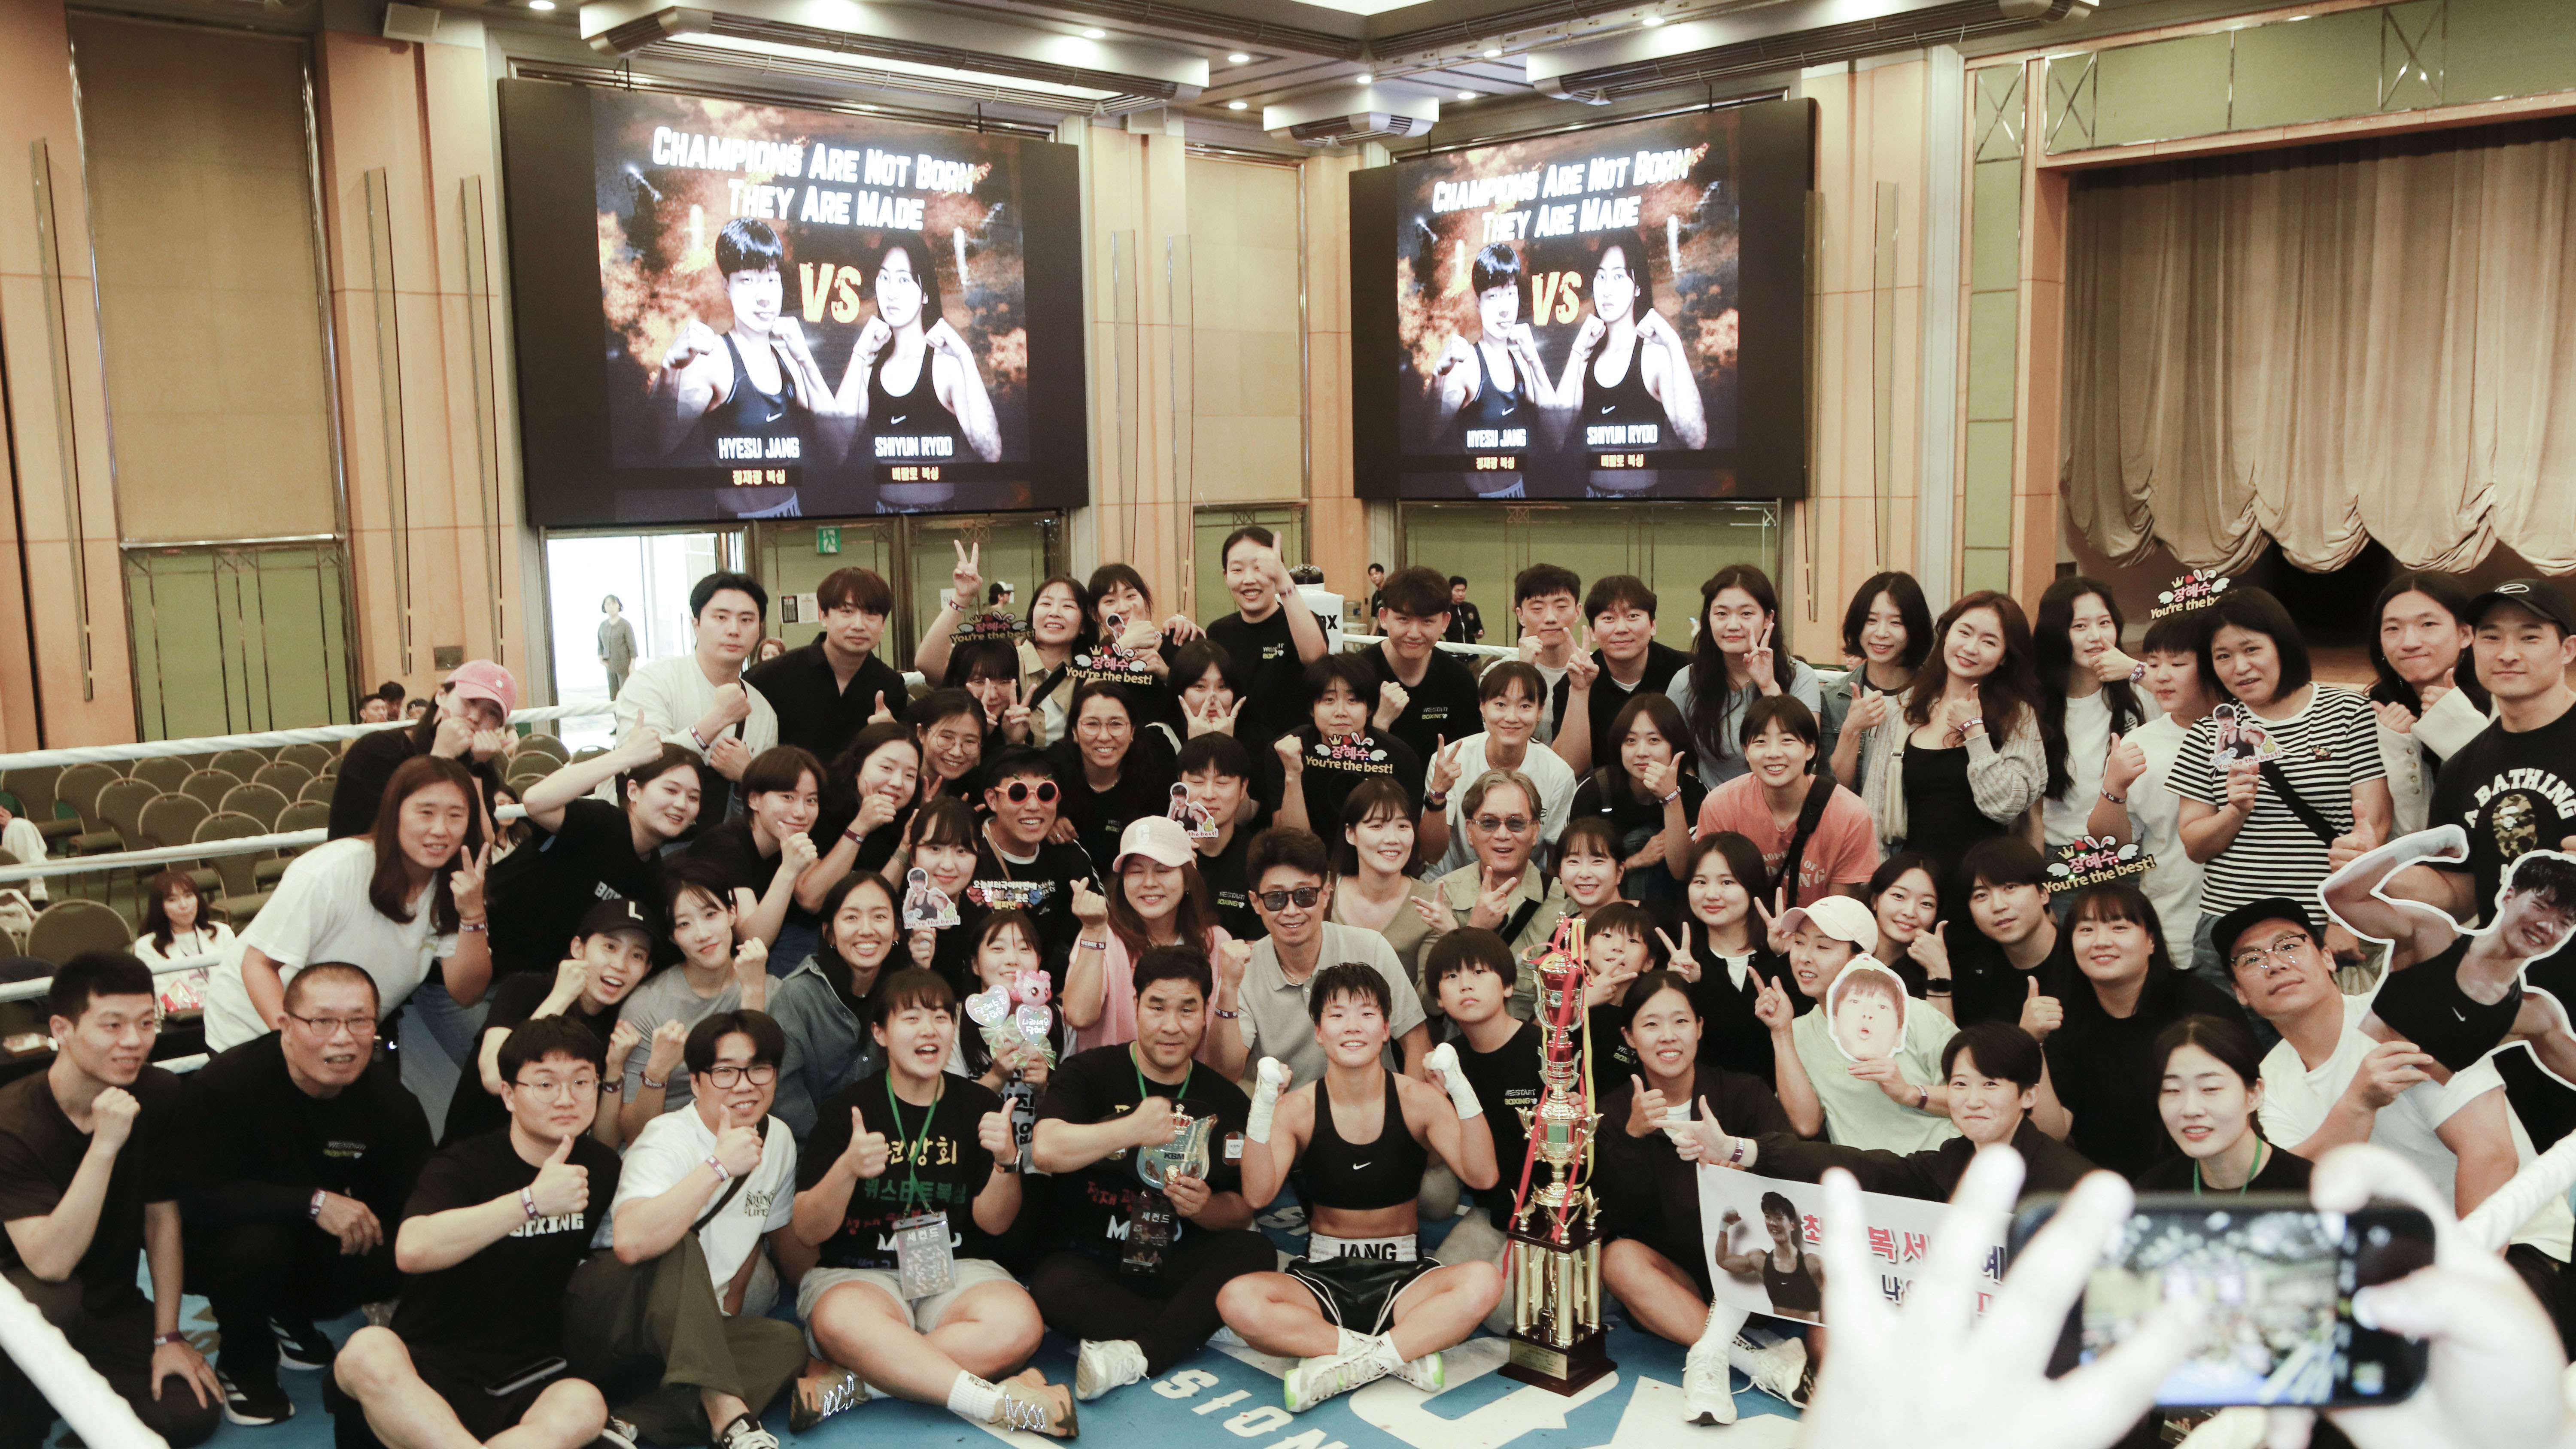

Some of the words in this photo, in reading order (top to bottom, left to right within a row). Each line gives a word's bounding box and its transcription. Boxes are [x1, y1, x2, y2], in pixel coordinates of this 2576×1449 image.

[652, 126, 802, 178] CHAMPIONS
[808, 143, 860, 183] ARE
[866, 147, 911, 190] NOT
[916, 153, 974, 194] BORN
[1432, 170, 1540, 213] CHAMPIONS
[1542, 162, 1583, 198] ARE
[1587, 157, 1627, 190] NOT
[1633, 149, 1690, 186] BORN
[727, 179, 790, 219] THEY
[801, 186, 851, 226] ARE
[857, 190, 925, 231] MADE
[1482, 210, 1529, 243] THEY
[1534, 205, 1575, 238] ARE
[1579, 196, 1641, 232] MADE
[799, 262, 862, 324] VS
[1531, 271, 1583, 326] VS
[718, 437, 762, 459] HYESU
[765, 437, 800, 459] JANG
[875, 436, 919, 457] SHIYUN
[1467, 429, 1498, 448] HYESU
[1500, 428, 1527, 447] JANG
[766, 469, 786, 484] 복싱
[921, 466, 939, 481] 복싱
[2174, 581, 2211, 602] 장혜수
[2151, 603, 2183, 619] You're
[2185, 598, 2206, 612] the
[987, 631, 1005, 639] the
[1092, 656, 1129, 671] 장혜수
[1066, 666, 1101, 679] You're
[1103, 671, 1121, 682] the
[1124, 672, 1153, 685] best!
[1332, 745, 1369, 760] 장혜수
[1305, 756, 1341, 769] You're
[1343, 759, 1362, 771] the
[1364, 760, 1393, 774] best!
[2464, 809, 2479, 829] A
[2474, 767, 2576, 820] BATHING
[1136, 824, 1150, 845] C
[1804, 860, 1818, 872] OF
[2068, 849, 2118, 874] 장혜수
[2042, 875, 2089, 893] You're
[2089, 869, 2116, 883] the
[2114, 856, 2157, 876] best!
[629, 900, 644, 921] L
